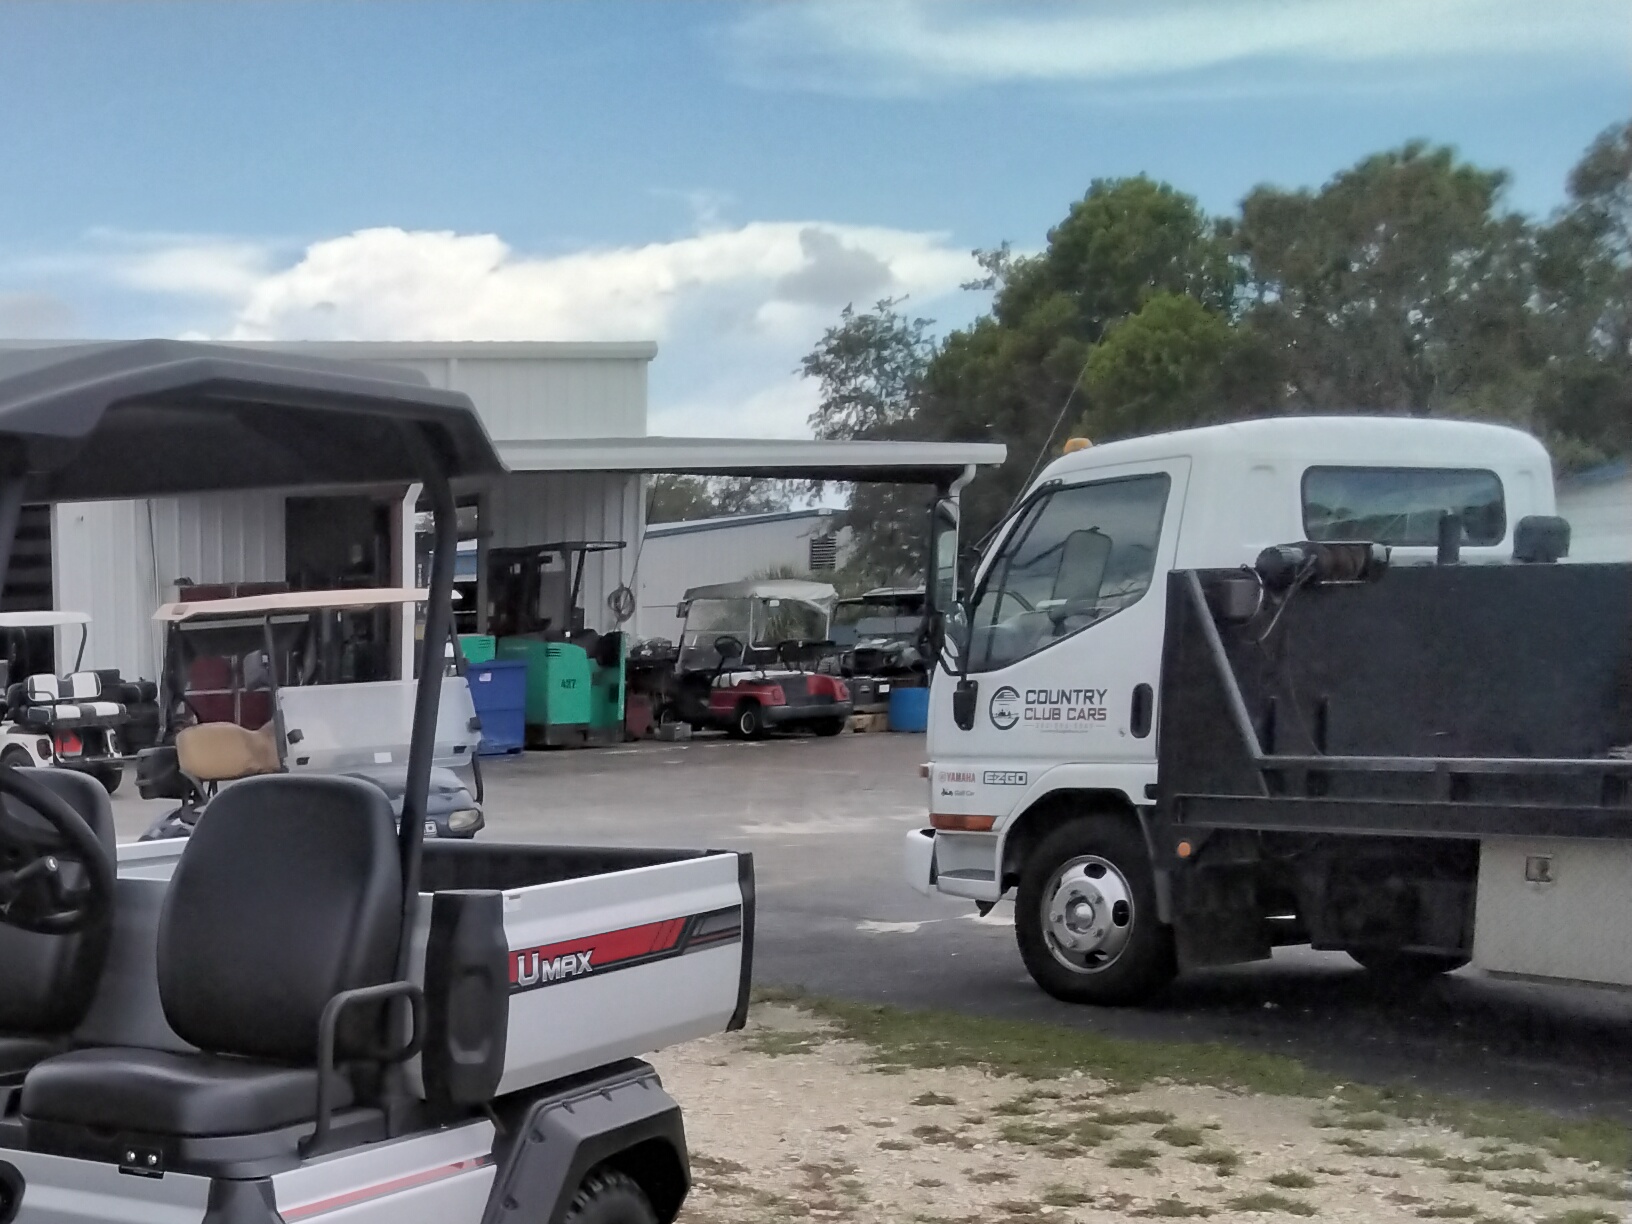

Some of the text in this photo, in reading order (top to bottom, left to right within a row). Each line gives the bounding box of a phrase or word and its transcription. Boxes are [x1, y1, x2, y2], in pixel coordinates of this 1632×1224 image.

[1025, 689, 1108, 705] COUNTRY
[1024, 708, 1107, 721] CLUB CARS
[947, 772, 1027, 785] YAMAHA EZGO
